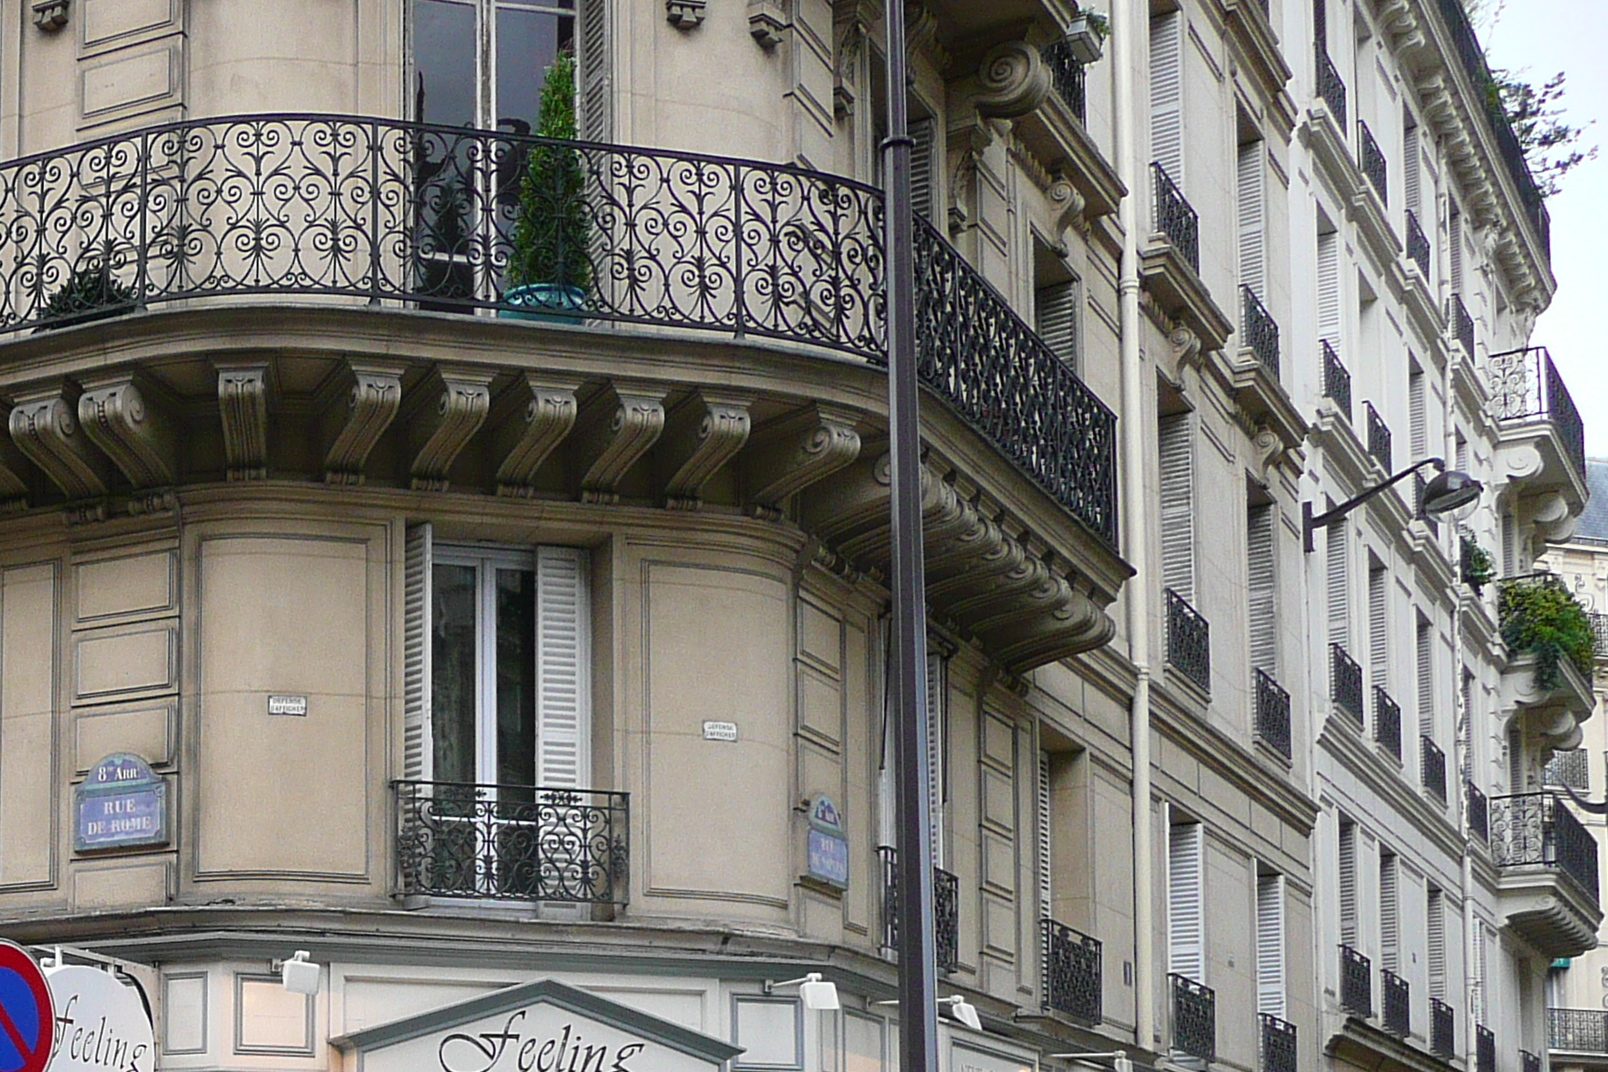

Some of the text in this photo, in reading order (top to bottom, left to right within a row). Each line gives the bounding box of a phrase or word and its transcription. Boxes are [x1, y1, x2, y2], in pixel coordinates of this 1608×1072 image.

[104, 799, 136, 815] RUE
[87, 816, 151, 835] DE ROME
